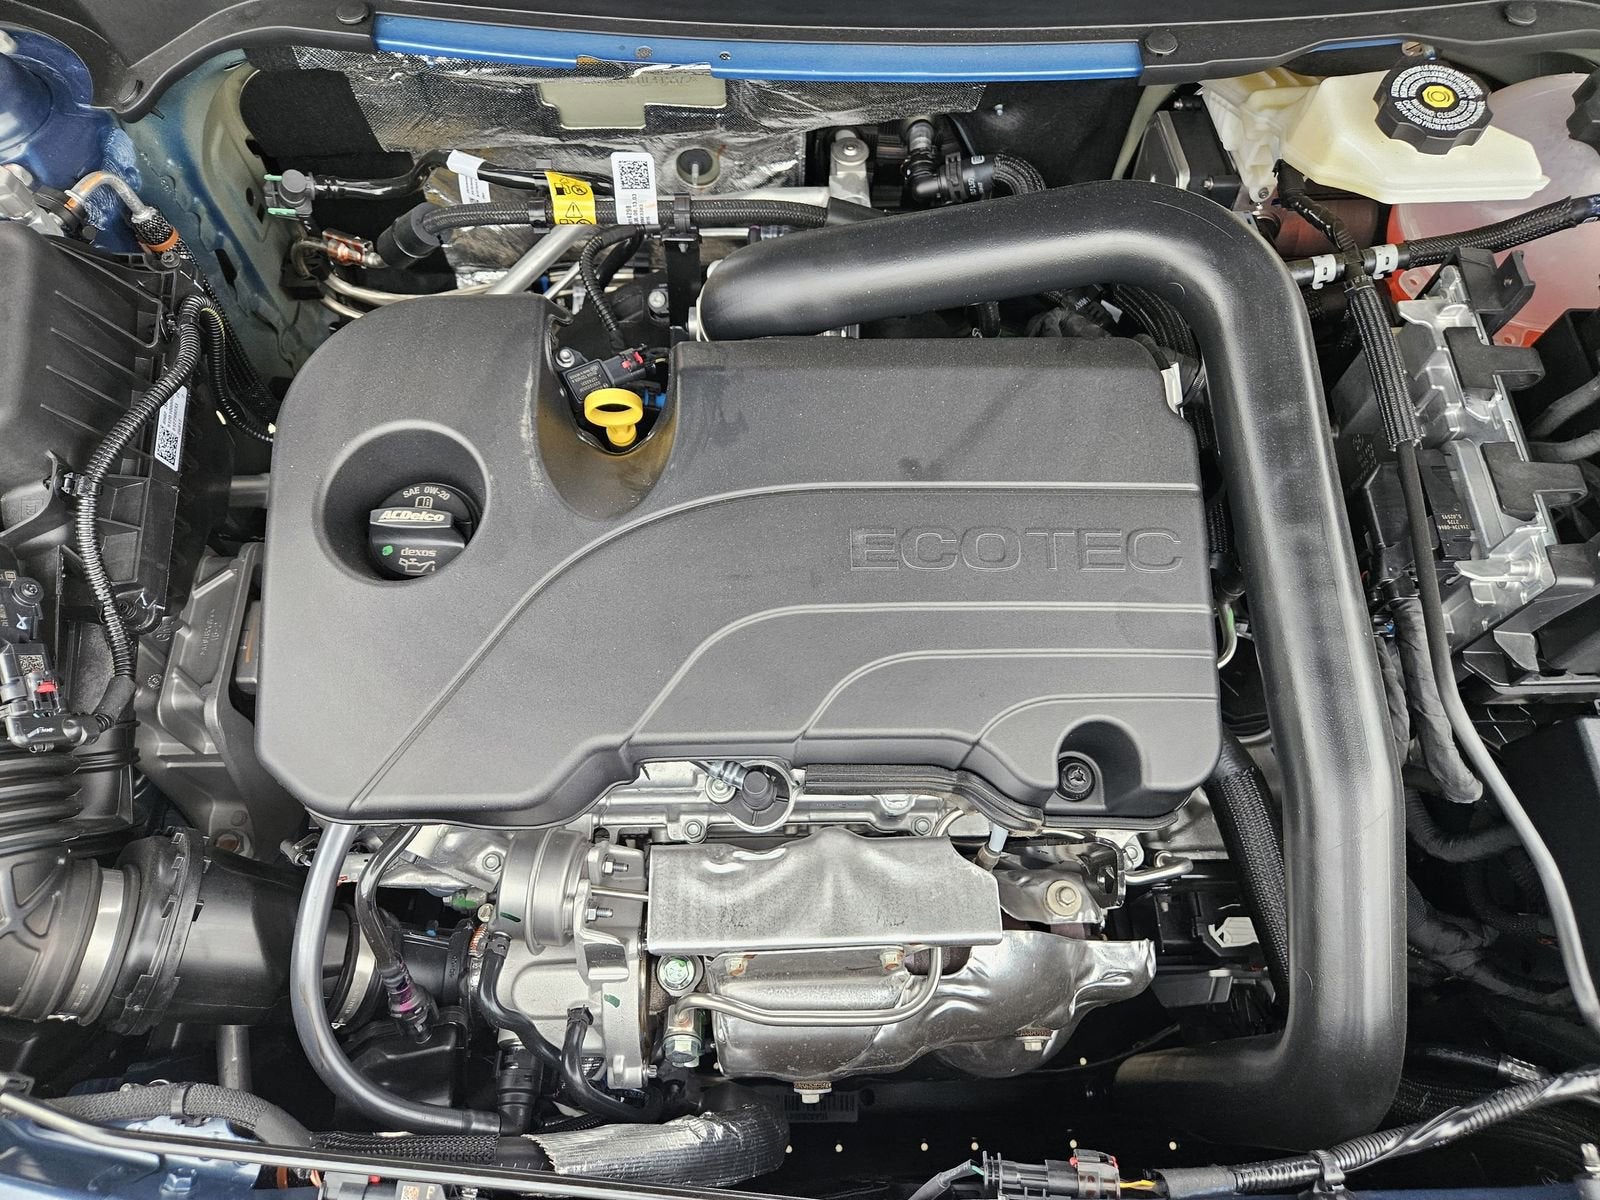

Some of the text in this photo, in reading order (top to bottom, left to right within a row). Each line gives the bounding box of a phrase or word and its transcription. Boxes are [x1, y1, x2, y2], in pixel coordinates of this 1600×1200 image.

[1404, 112, 1423, 125] FLUID
[1421, 121, 1441, 130] FROM
[403, 486, 450, 501] SAE 0W-20
[378, 510, 445, 522] ACDelco
[401, 547, 437, 556] dexos
[850, 526, 1183, 573] ECOTEC
